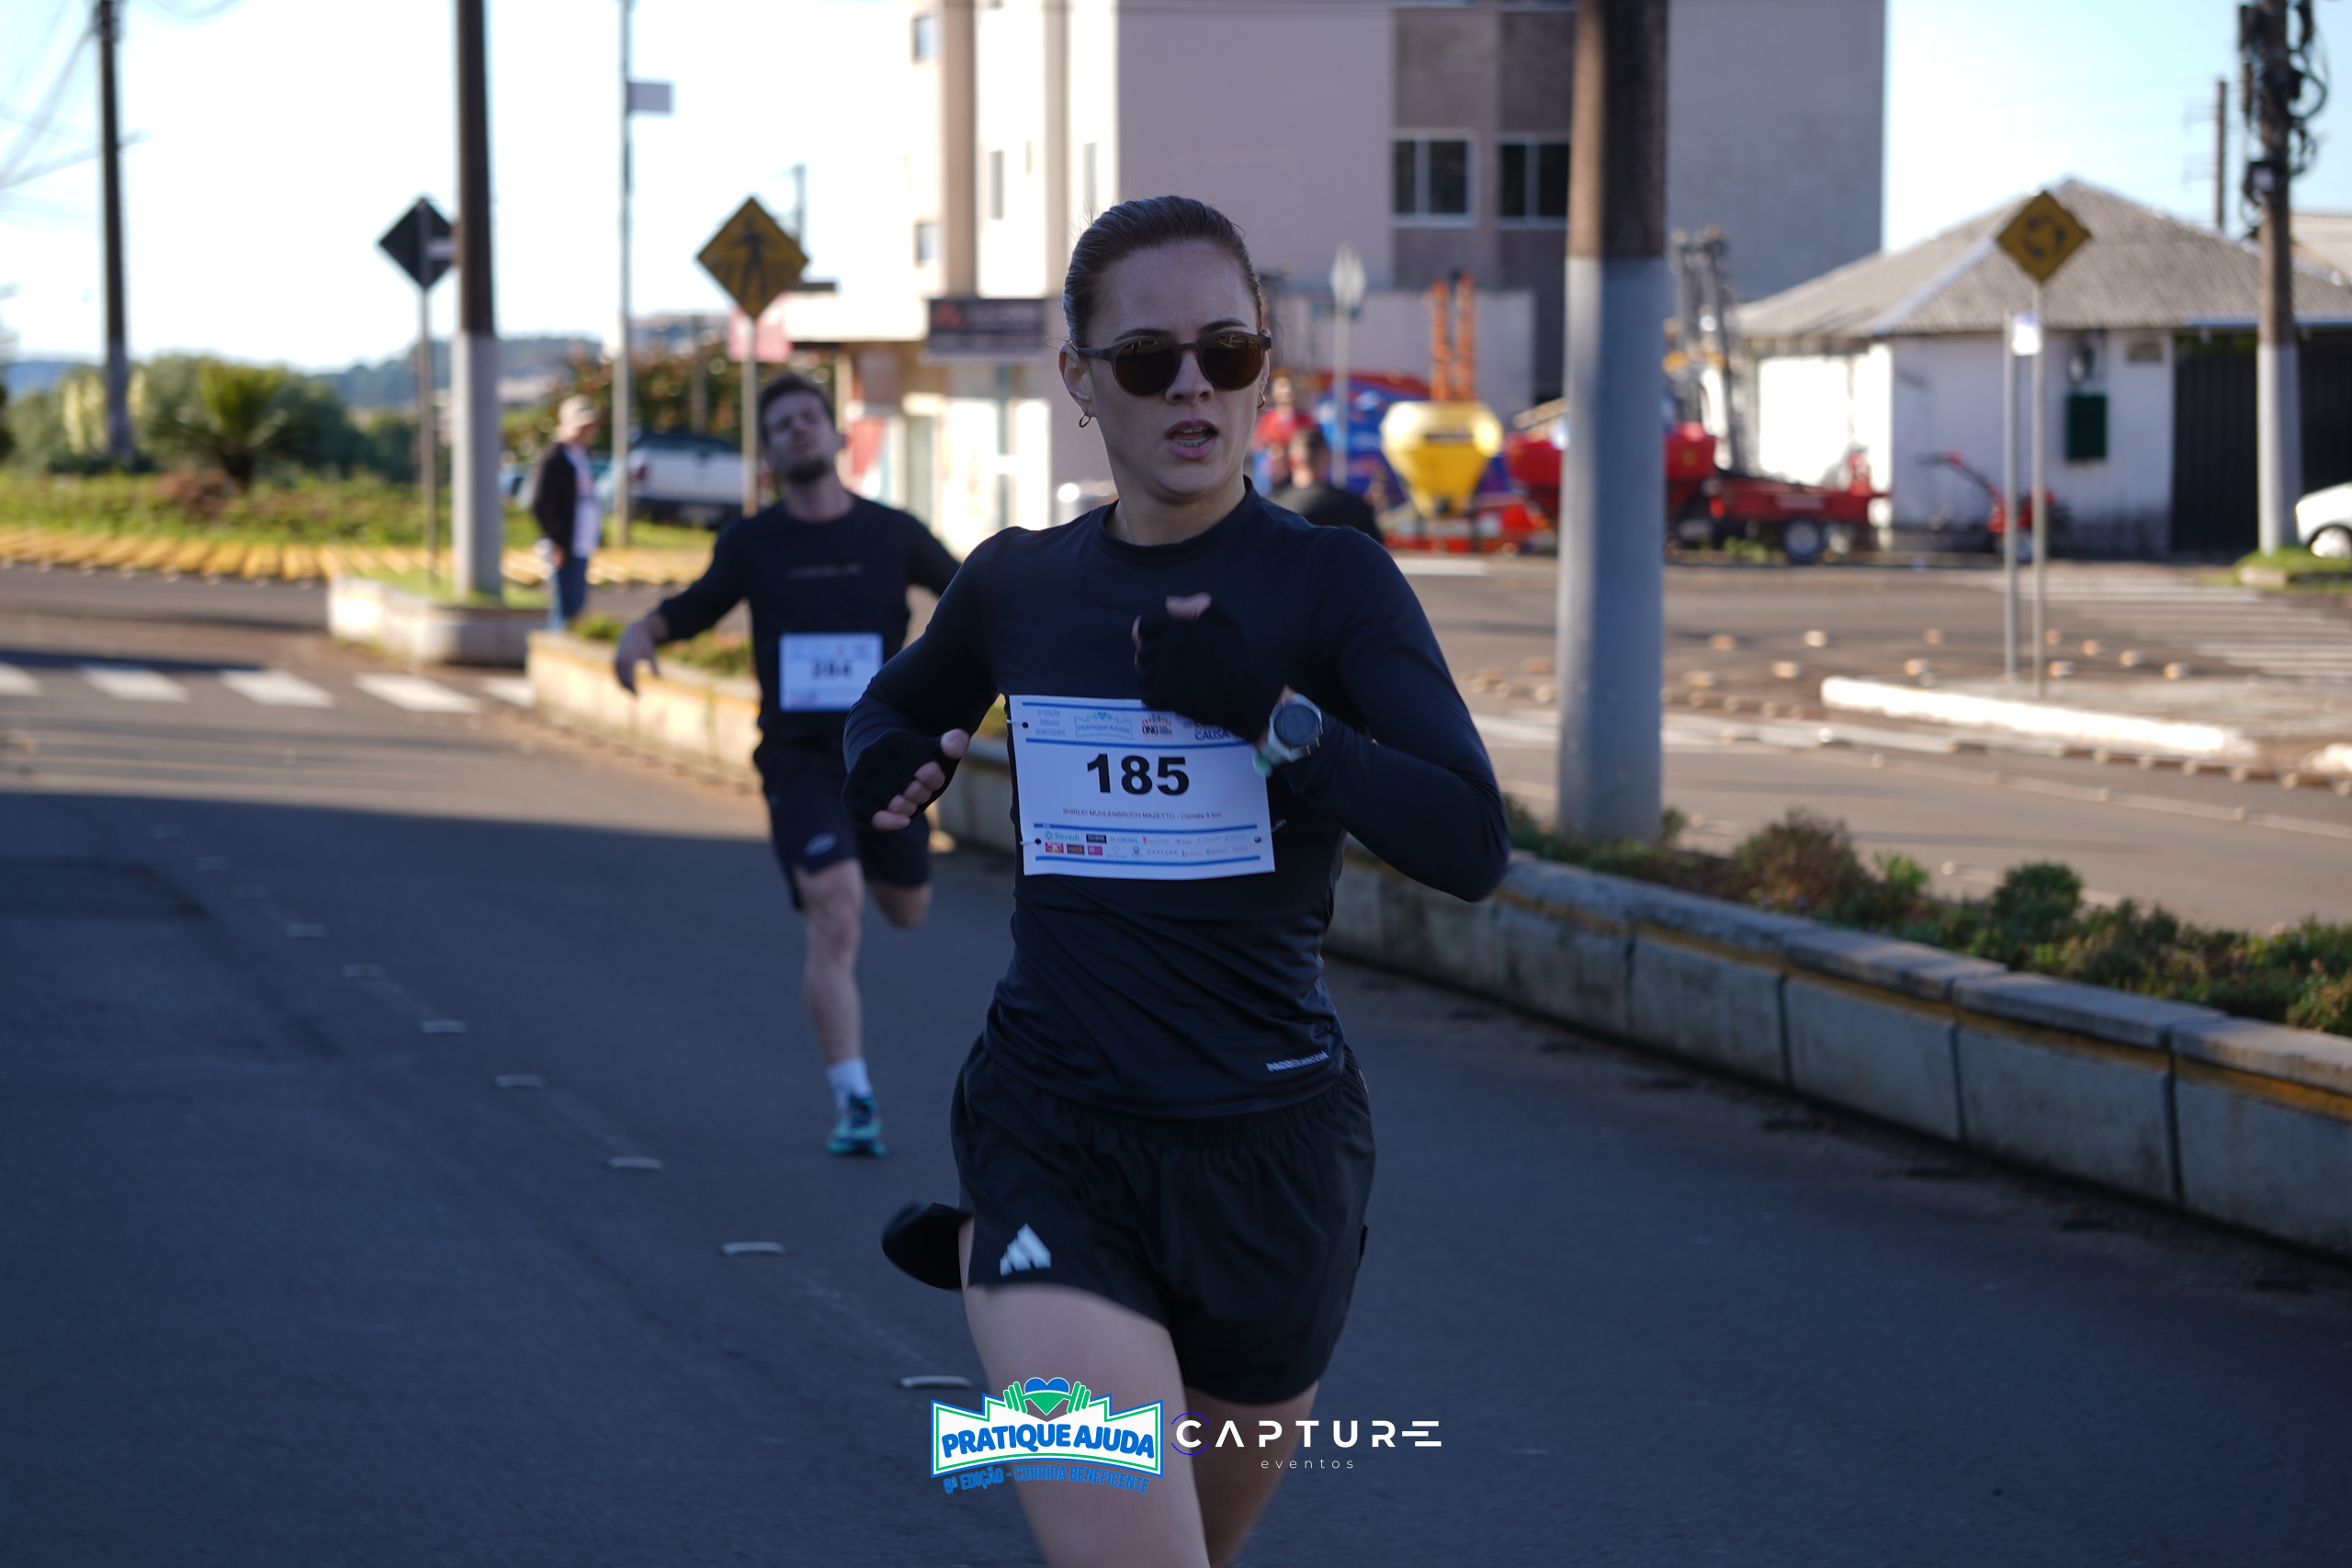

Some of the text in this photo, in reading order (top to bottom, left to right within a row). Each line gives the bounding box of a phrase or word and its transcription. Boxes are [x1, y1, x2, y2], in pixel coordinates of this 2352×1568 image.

[1077, 724, 1130, 734] PRATIQUE AJUDA
[1194, 728, 1230, 741] CAUSA
[1087, 753, 1190, 796] 185
